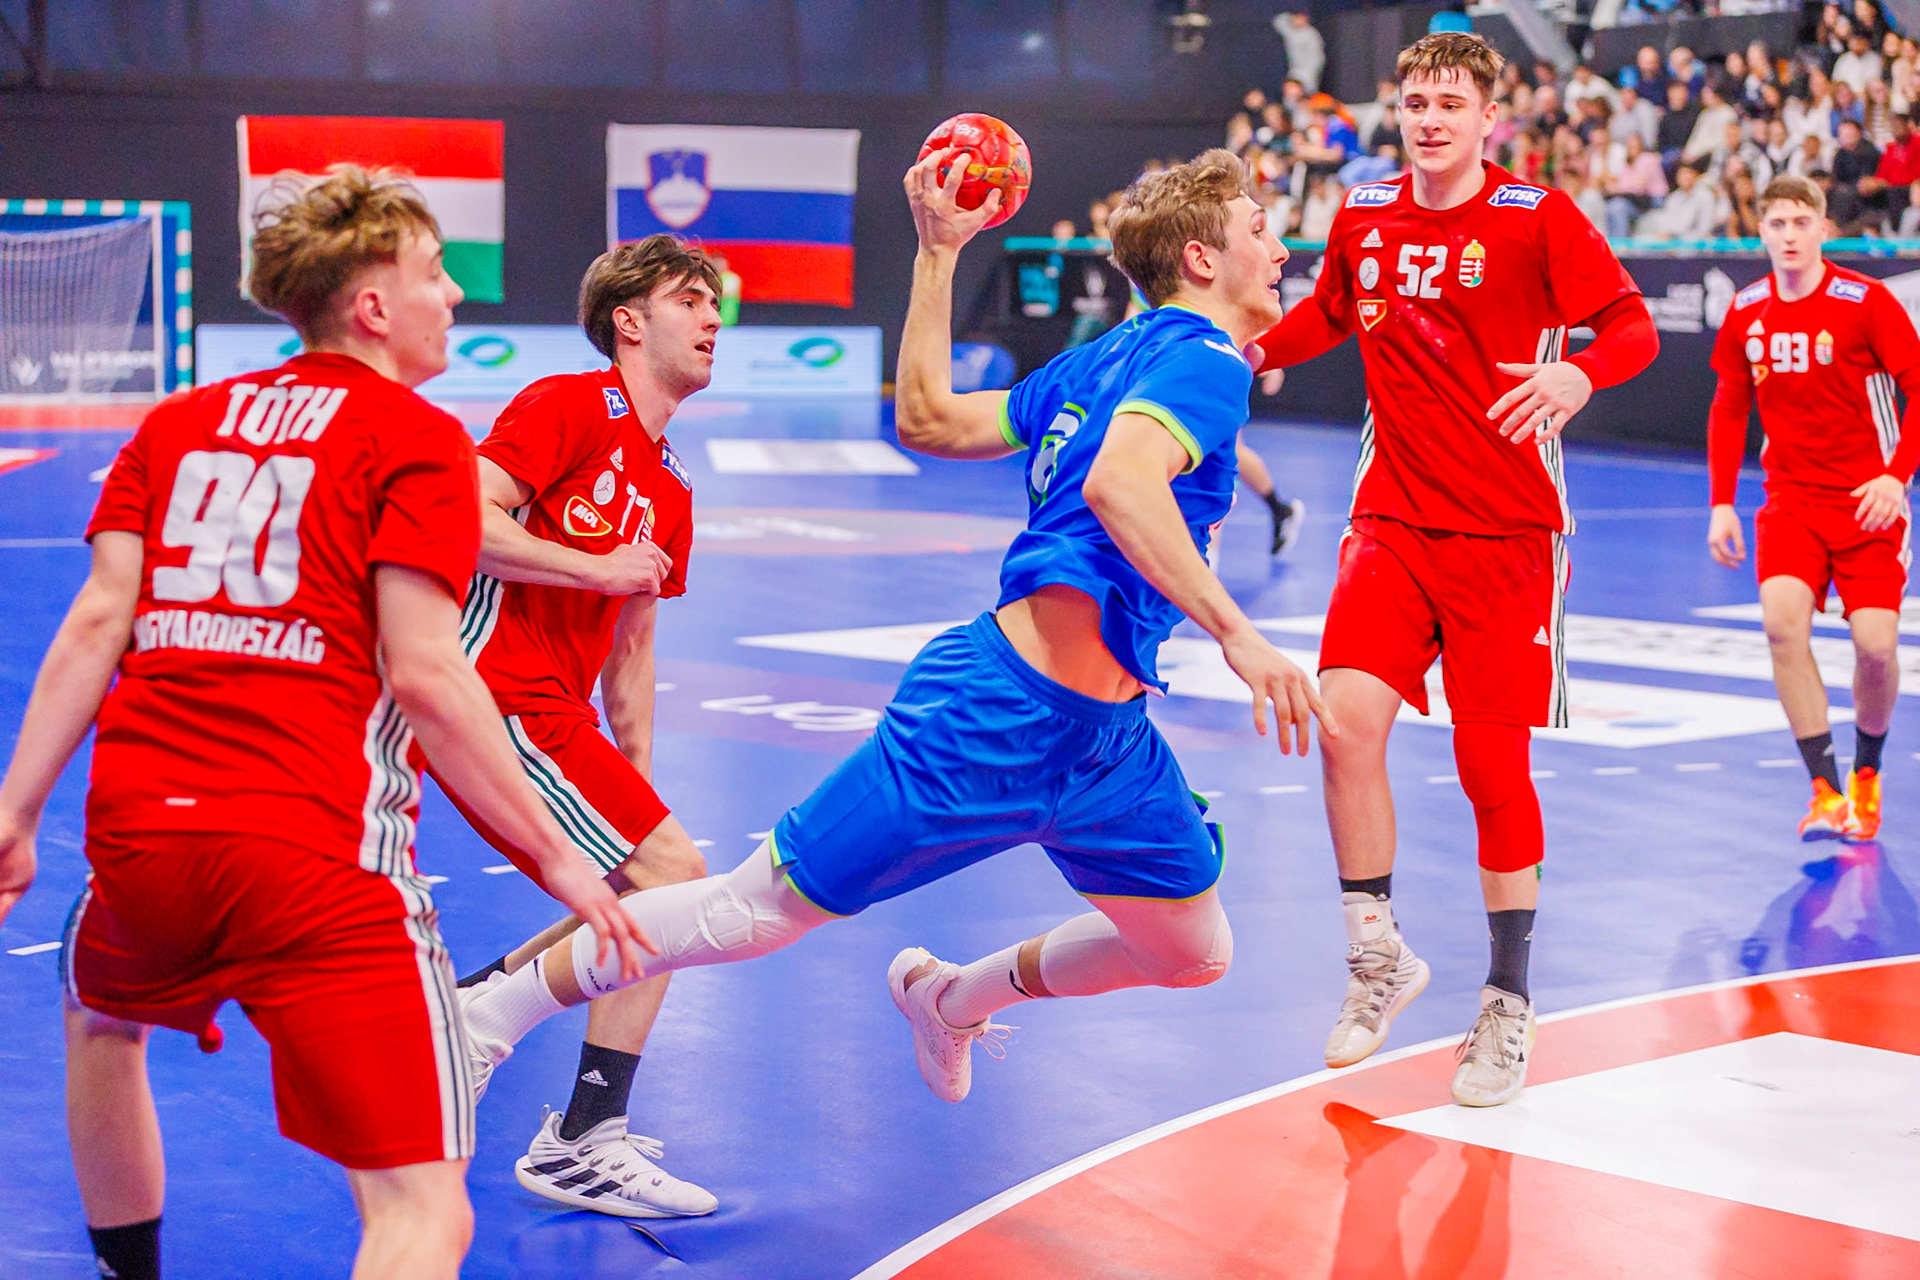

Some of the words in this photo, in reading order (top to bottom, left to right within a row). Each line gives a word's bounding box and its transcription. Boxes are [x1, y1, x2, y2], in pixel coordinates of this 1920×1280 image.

[1500, 189, 1541, 203] JYSK
[1396, 243, 1448, 299] 52
[1770, 332, 1809, 373] 93
[215, 374, 349, 446] TÓTH
[152, 450, 316, 607] 90
[571, 504, 599, 528] MOL
[617, 480, 651, 546] 17
